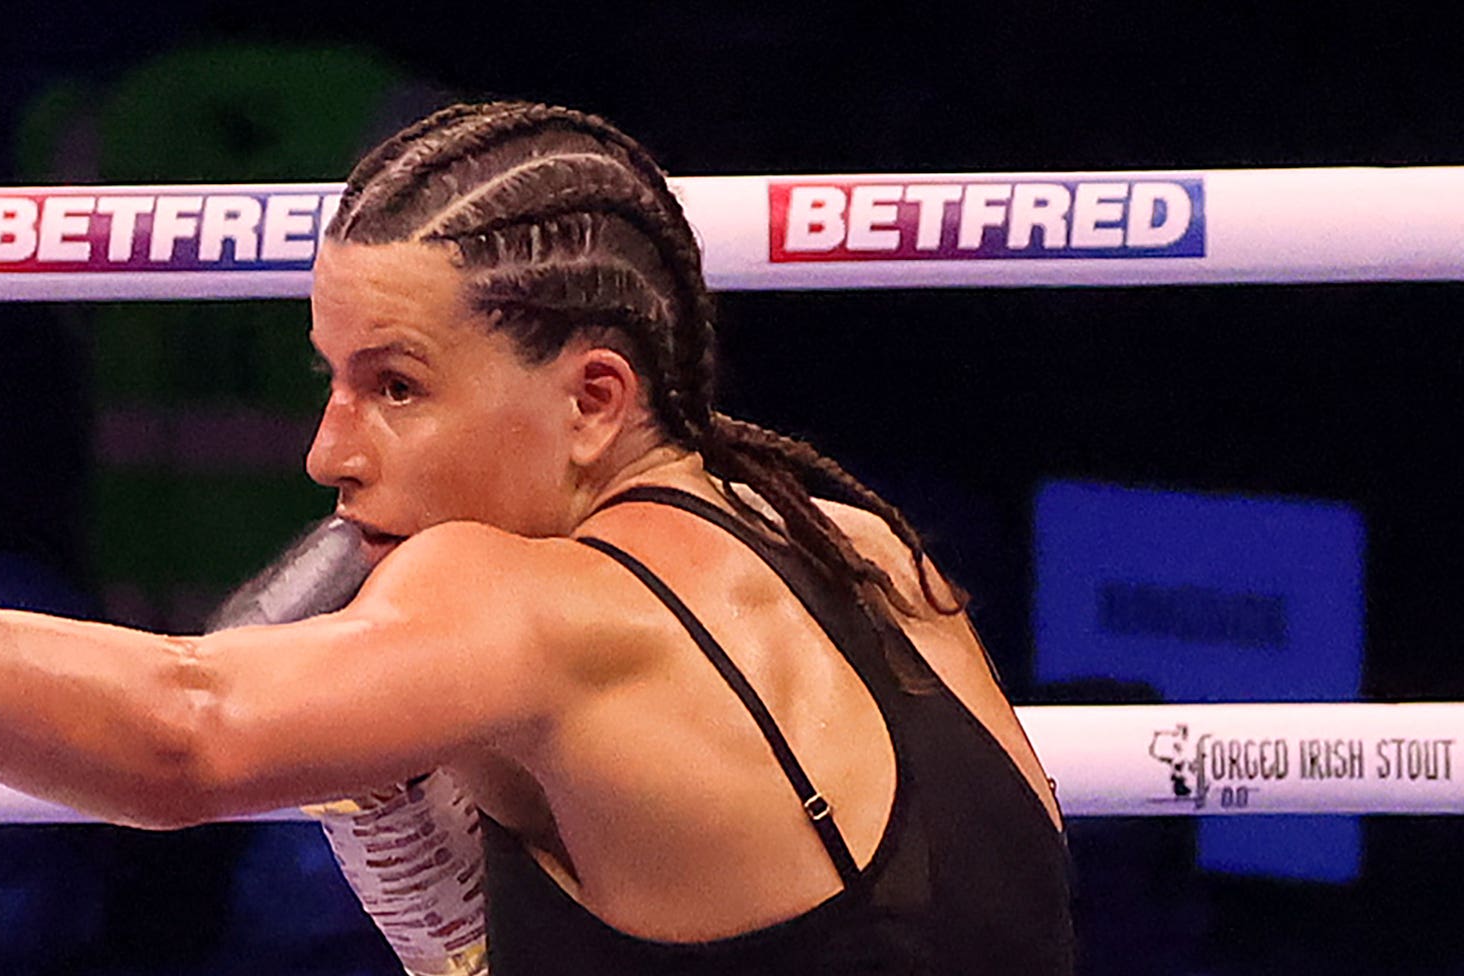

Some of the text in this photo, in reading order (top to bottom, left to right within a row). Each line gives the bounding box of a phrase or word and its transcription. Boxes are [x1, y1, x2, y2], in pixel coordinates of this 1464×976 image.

[784, 180, 1193, 252] BETFRED
[1299, 738, 1364, 781] IRISH
[1376, 737, 1456, 782] STOUT
